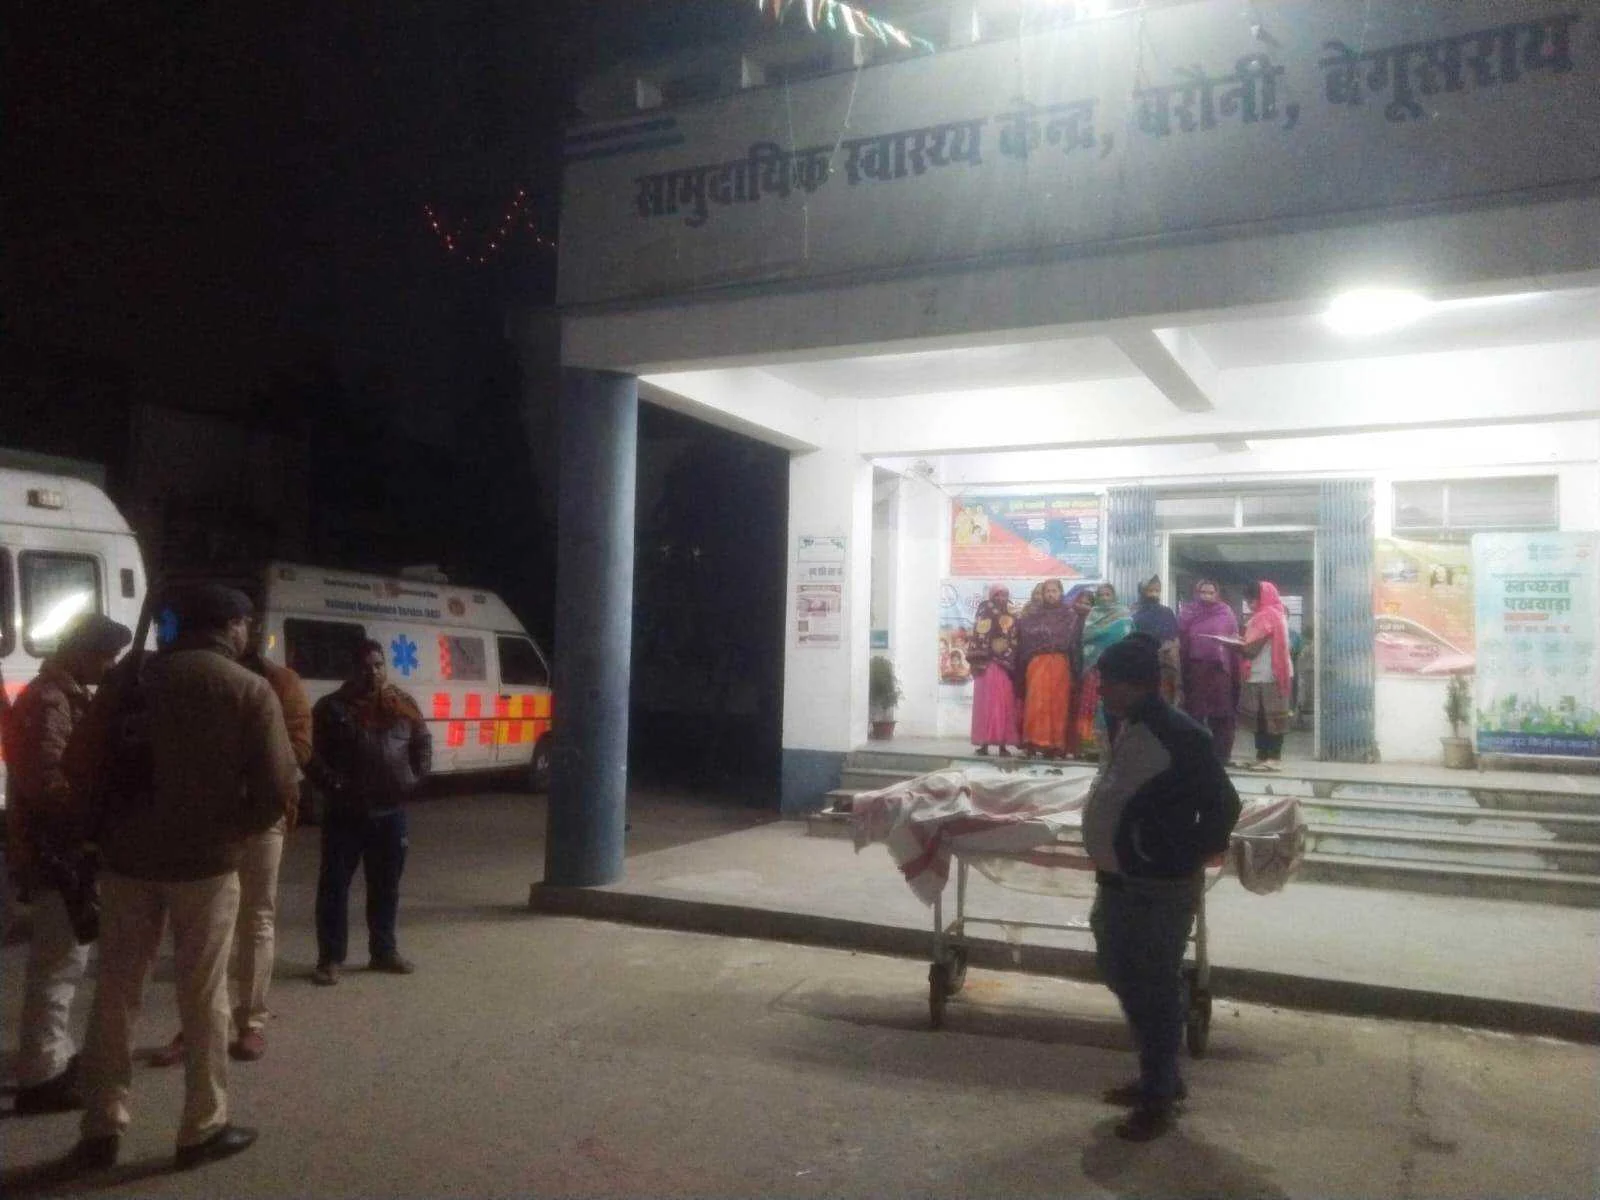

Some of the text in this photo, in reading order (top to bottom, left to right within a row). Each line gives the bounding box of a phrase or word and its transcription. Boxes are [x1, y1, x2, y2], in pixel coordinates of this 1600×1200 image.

[635, 141, 832, 227] सामुदायिक
[844, 117, 988, 186] स्वास्थ्य
[1318, 14, 1579, 122] बेगूसराय
[1504, 579, 1570, 593] स्वच्छता
[1503, 597, 1571, 614] पखवाड़ा
